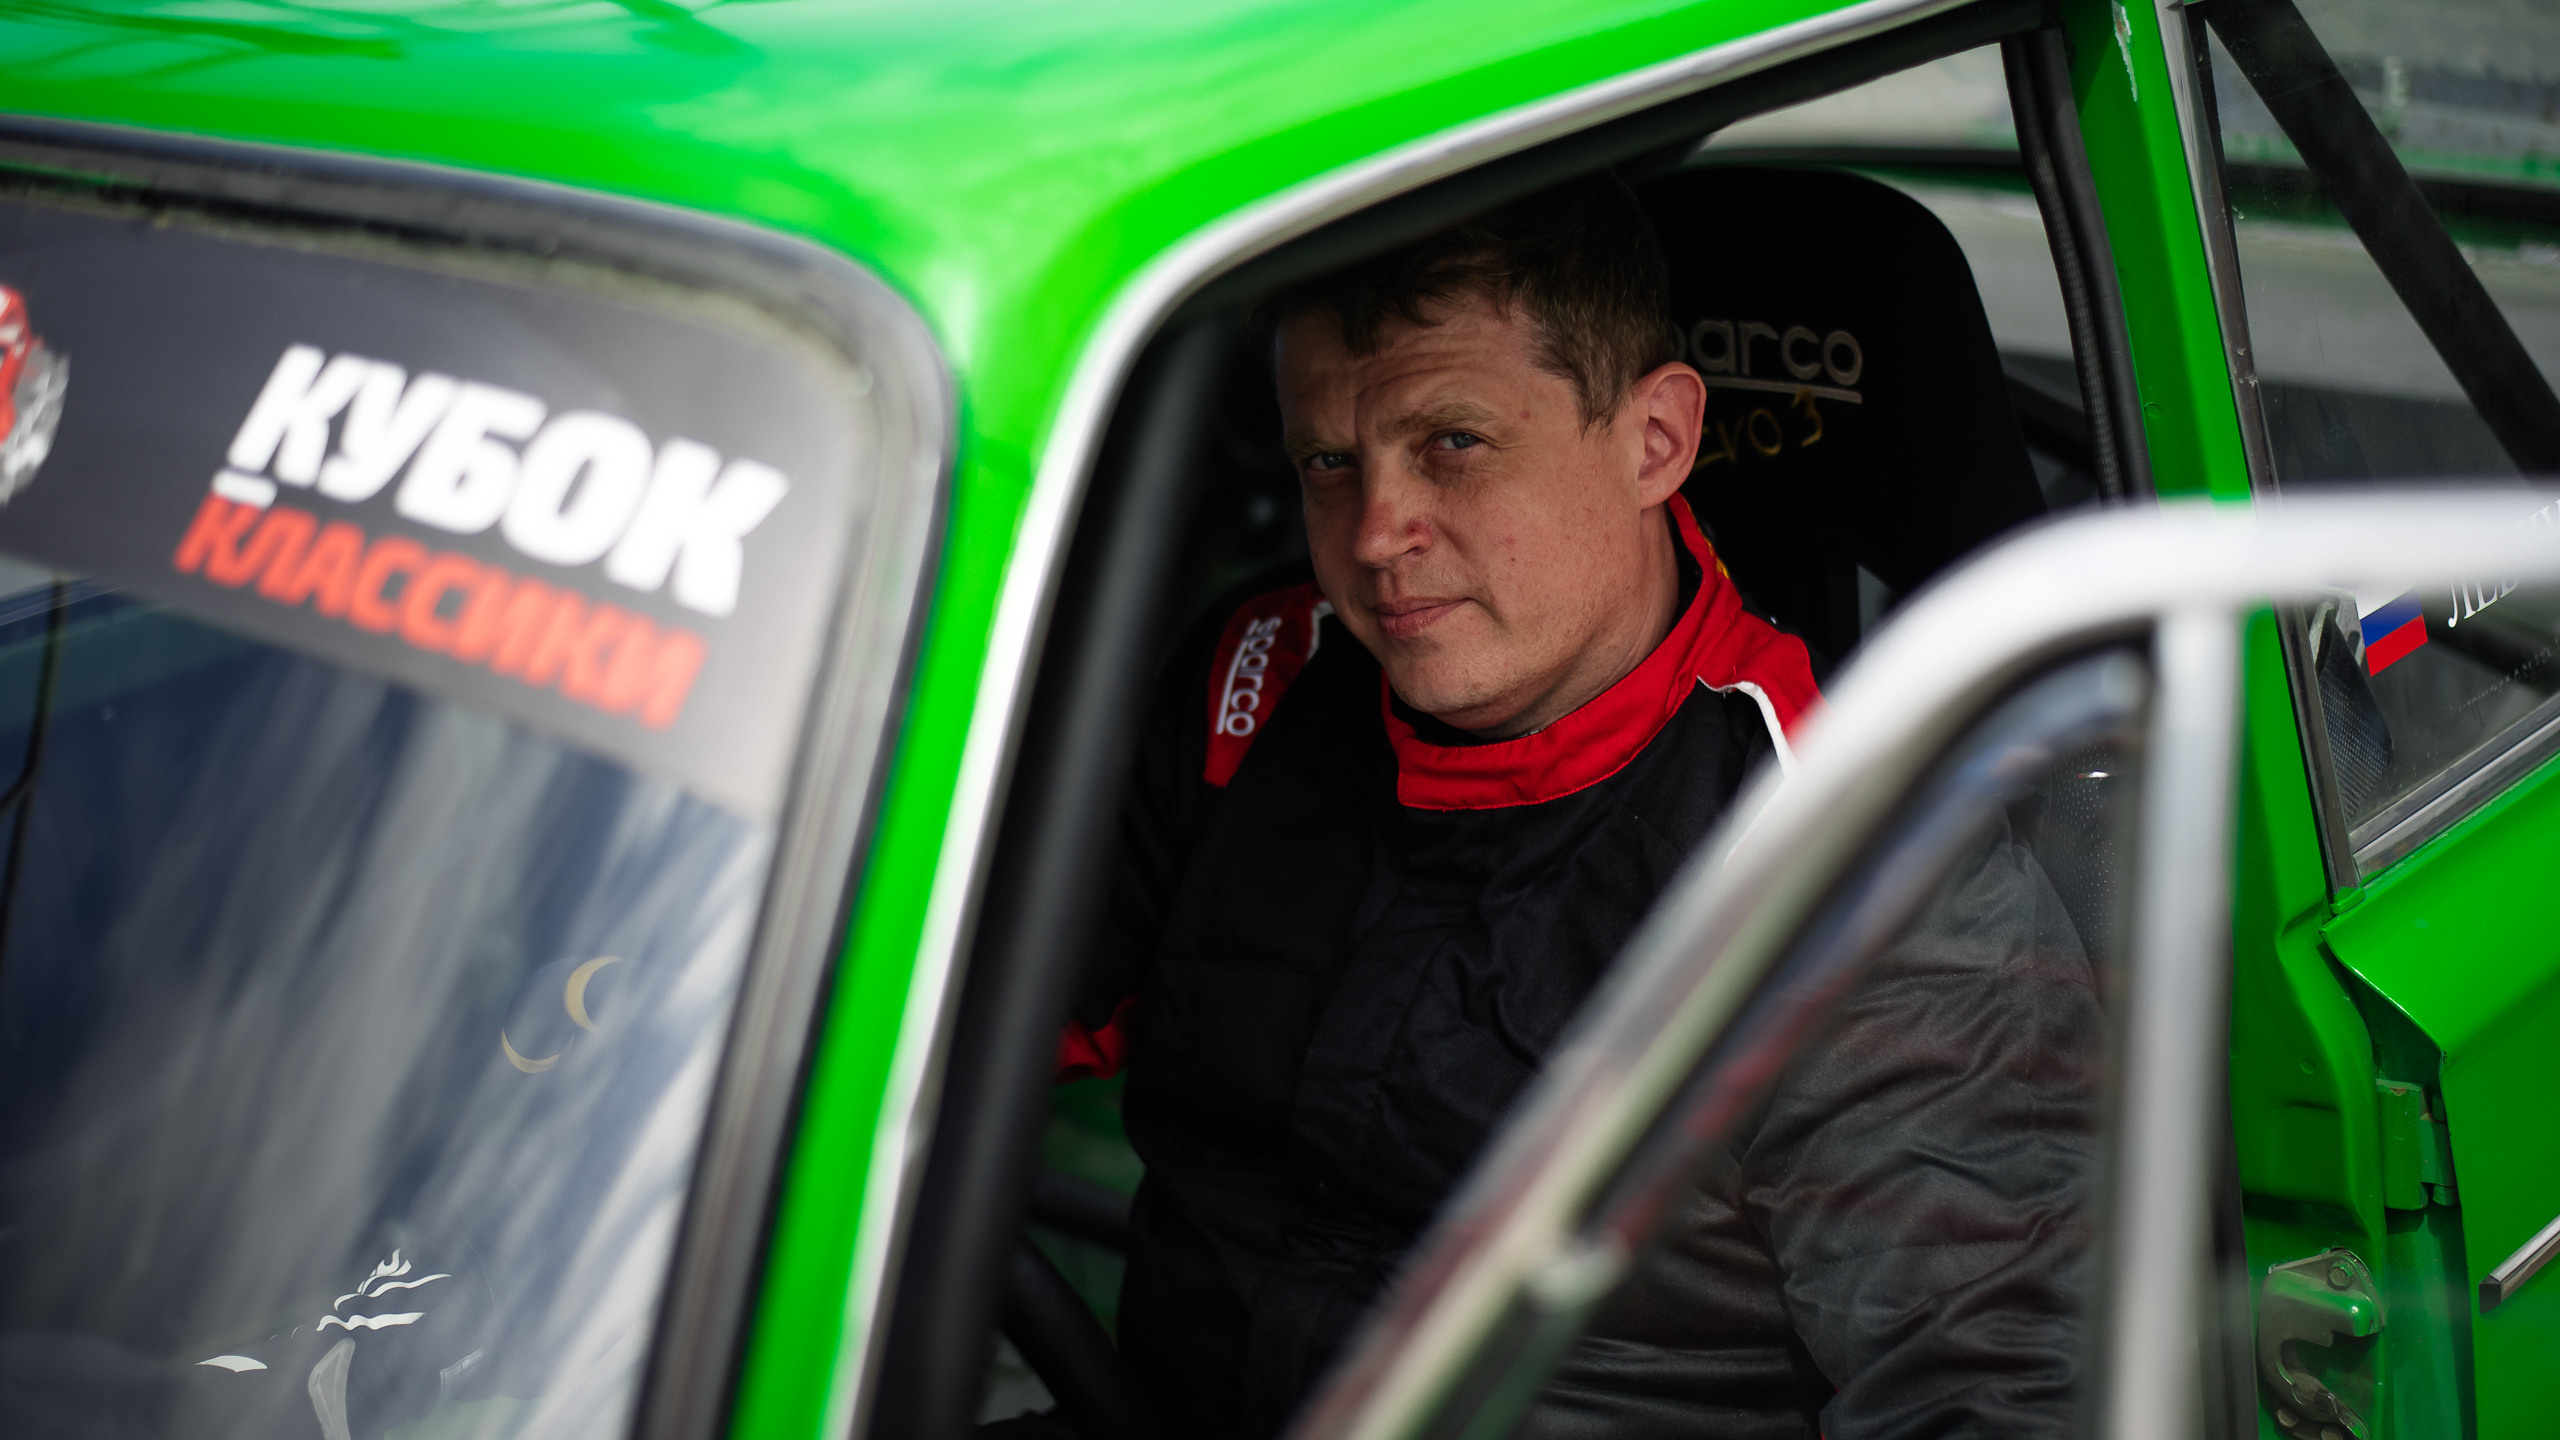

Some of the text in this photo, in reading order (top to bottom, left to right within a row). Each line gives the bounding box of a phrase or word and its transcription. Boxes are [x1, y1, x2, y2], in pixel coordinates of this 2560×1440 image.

[1671, 319, 1863, 387] arco
[228, 343, 789, 617] КУБОК
[173, 490, 708, 731] КЛАССИКИ
[1225, 616, 1282, 736] sparco
